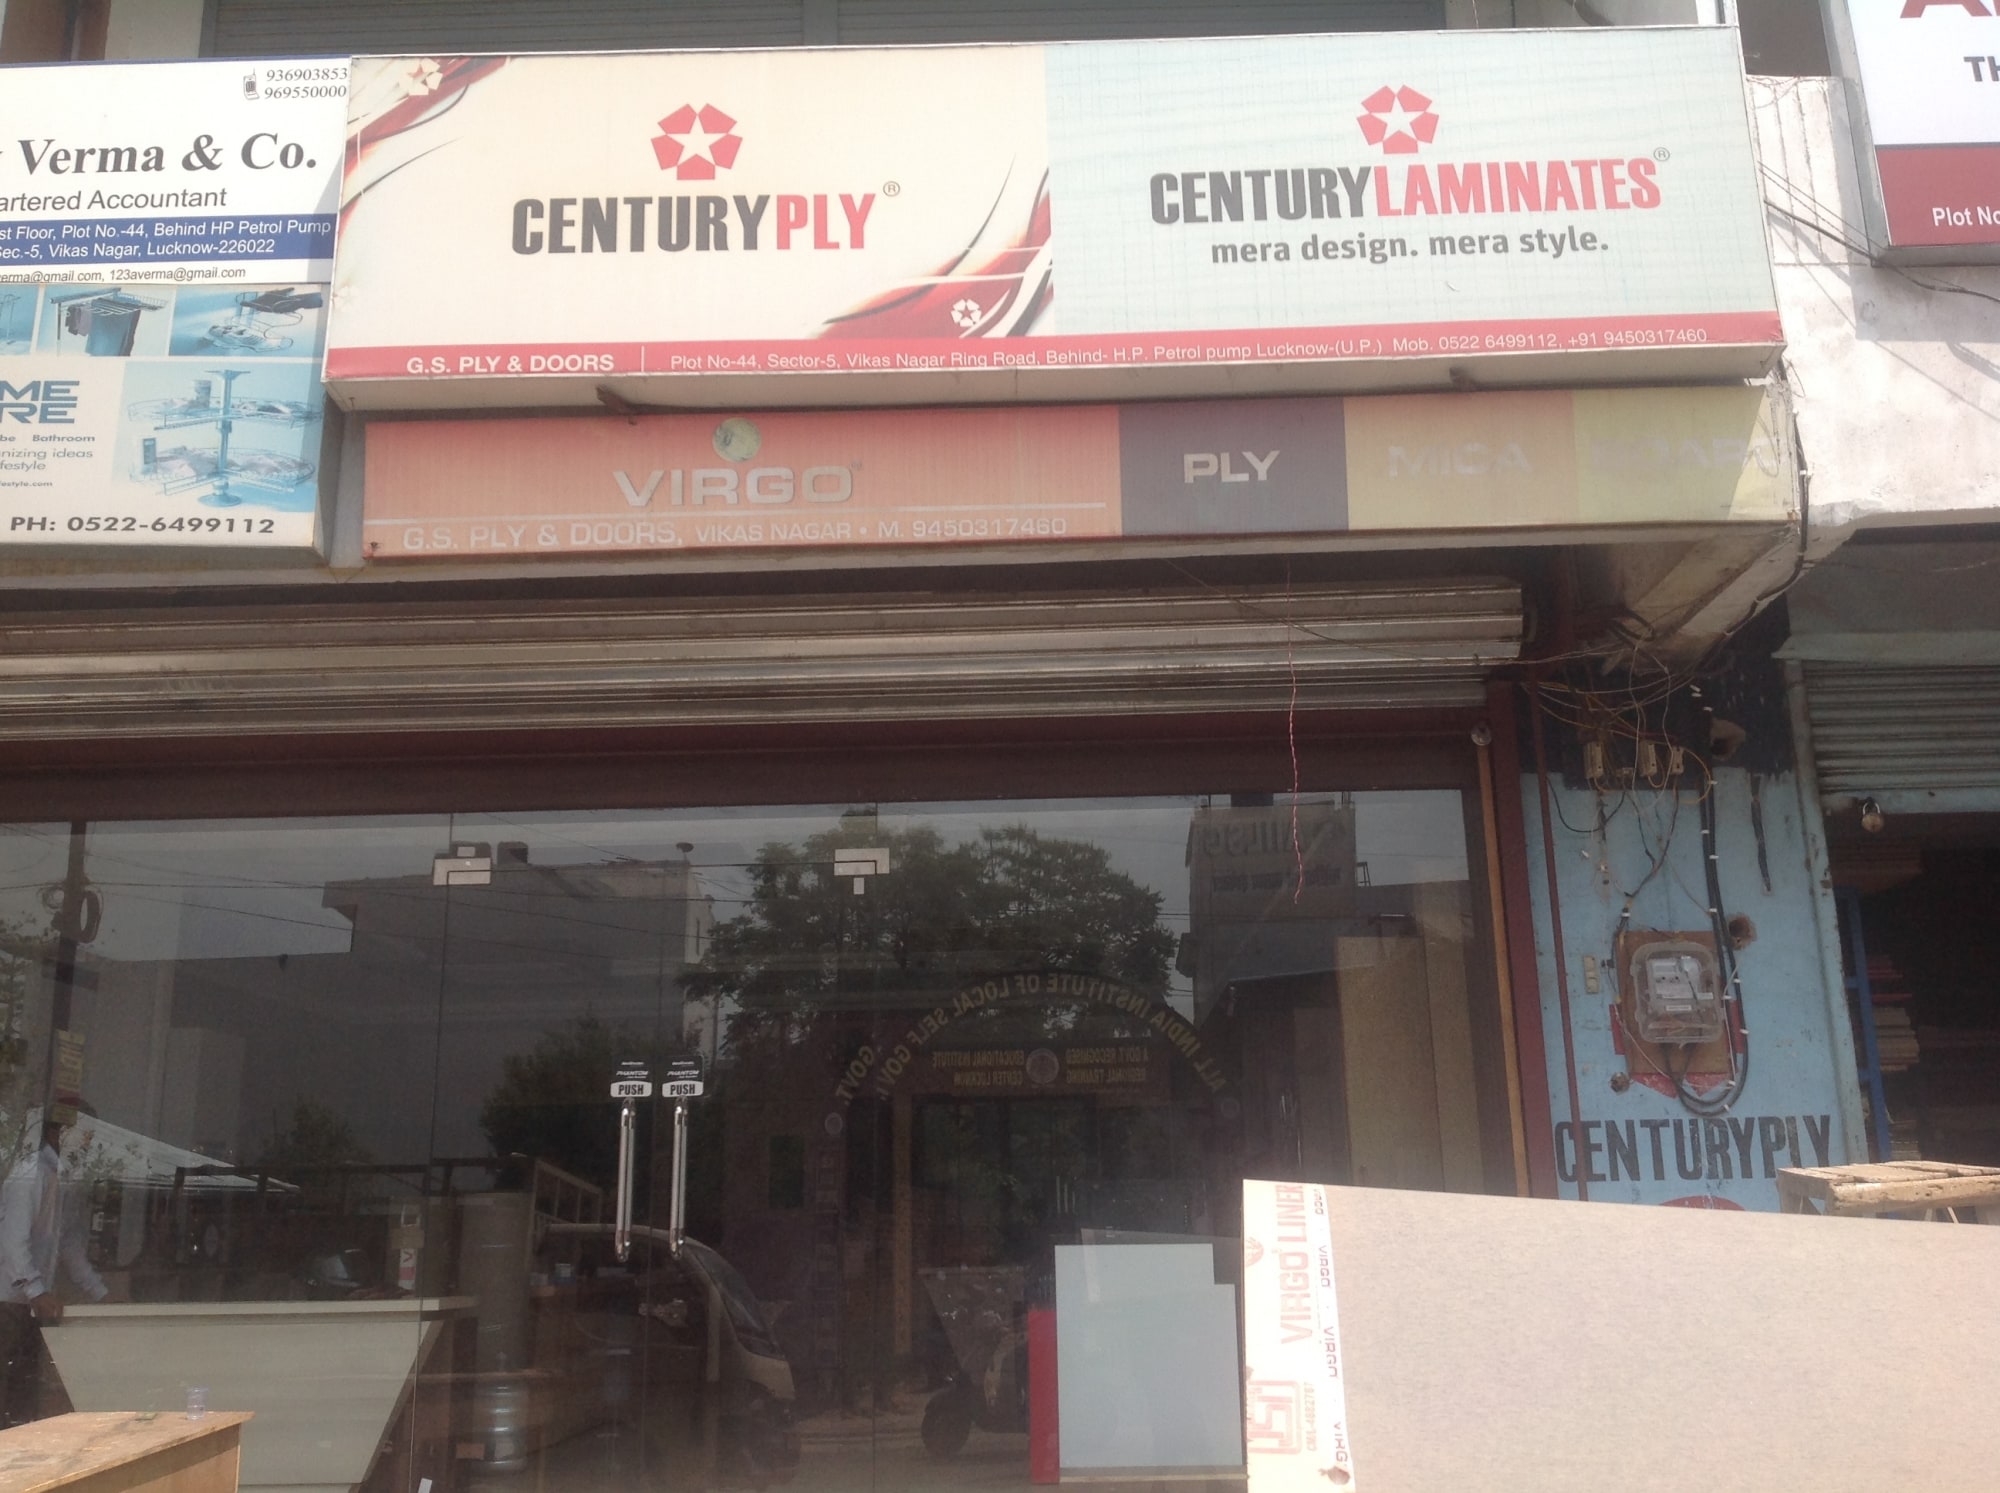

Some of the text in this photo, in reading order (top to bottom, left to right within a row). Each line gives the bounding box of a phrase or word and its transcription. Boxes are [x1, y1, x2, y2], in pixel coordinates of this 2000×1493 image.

[18, 132, 317, 176] Verma & Co.
[88, 187, 228, 211] Accountant
[1149, 157, 1662, 225] CENTURYLAMINATES
[16, 225, 56, 241] Floor,
[62, 224, 91, 239] Plot
[154, 221, 206, 237] Behind
[210, 221, 235, 236] HP
[239, 219, 282, 235] Petrol
[287, 219, 331, 237] Pump
[511, 193, 877, 256] CENTURYPLY
[1932, 207, 1974, 226] Plot
[48, 243, 88, 258] Vikas
[93, 242, 141, 259] Nagar,
[147, 238, 276, 256] Lucknow-226022
[1212, 225, 1609, 265] mera design. mera style.
[406, 354, 614, 374] G.S. PLY & DOORS
[671, 355, 702, 369] Plot
[707, 354, 761, 369] No-44,
[767, 353, 840, 369] Sector-5,
[846, 352, 890, 368] Vikas
[896, 352, 945, 369] Nagar
[951, 351, 987, 368] Ring
[993, 350, 1040, 366] Road,
[1154, 345, 1201, 361] Petrol
[1206, 345, 1251, 361] pump
[1393, 338, 1433, 352] Mob.
[1439, 335, 1480, 350] 0522
[1485, 333, 1562, 349] 6499112,
[1568, 331, 1597, 347] +91
[1604, 328, 1707, 345] 9450317460
[32, 434, 95, 442] Bathroom
[52, 448, 93, 458] ideas
[1183, 450, 1281, 484] PLY
[1387, 443, 1534, 479] MICA
[613, 466, 853, 507] VIRGO
[10, 516, 275, 534] PH: 0522-6499112
[403, 527, 458, 550] G.S.
[470, 525, 527, 548] PLY
[537, 523, 560, 546] &
[570, 521, 683, 547] DOORS,
[696, 524, 762, 543] VIKAS
[770, 522, 851, 541] NAGAR
[912, 518, 1066, 538] 9450317460
[618, 1085, 644, 1095] PUSH
[670, 1084, 695, 1095] PUSH
[1554, 1114, 1831, 1182] CENTURYPLY
[1279, 1251, 1313, 1345] VIRGO
